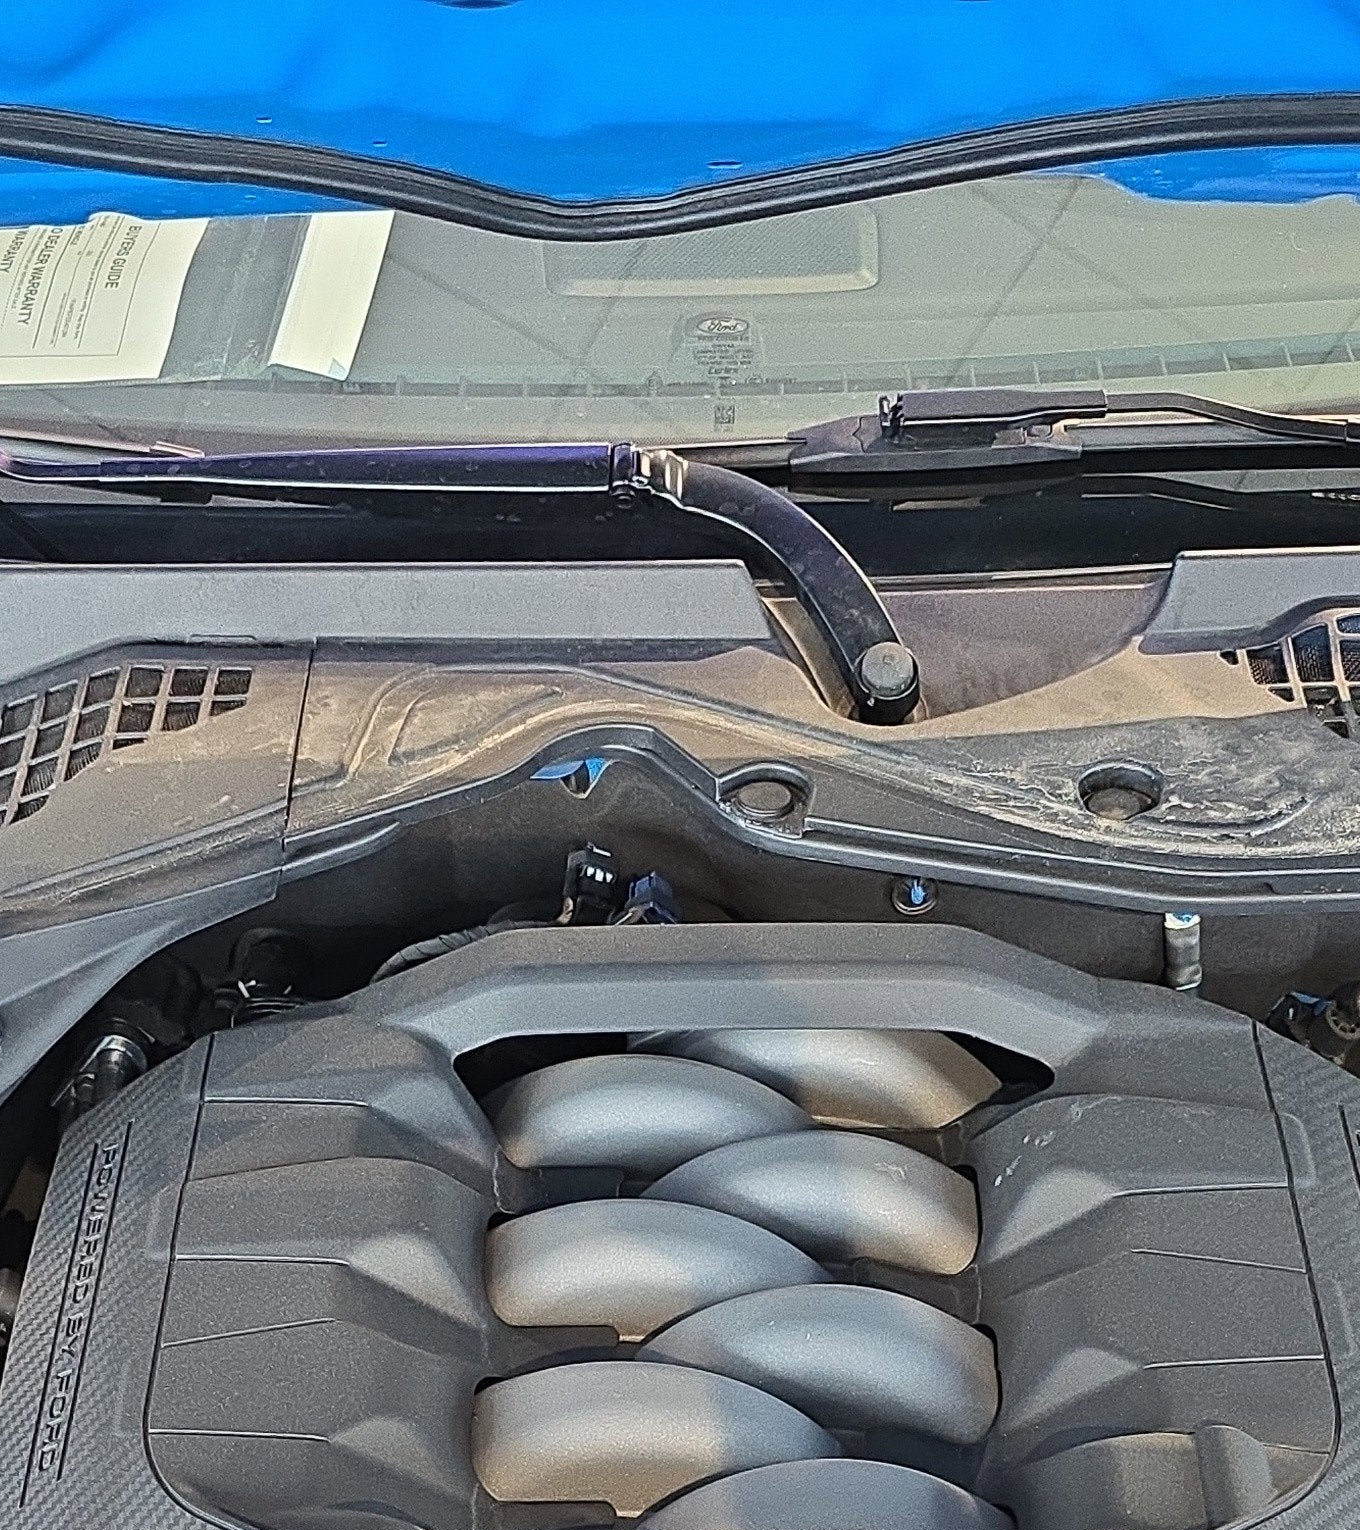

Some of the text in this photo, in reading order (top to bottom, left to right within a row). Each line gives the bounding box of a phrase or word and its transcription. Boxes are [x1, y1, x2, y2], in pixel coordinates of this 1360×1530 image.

[34, 235, 59, 265] DEALER
[105, 225, 143, 289] BUYERS GUIDE
[17, 266, 43, 326] WARRANTY
[69, 1141, 118, 1305] POWERED
[58, 1315, 86, 1357] BY
